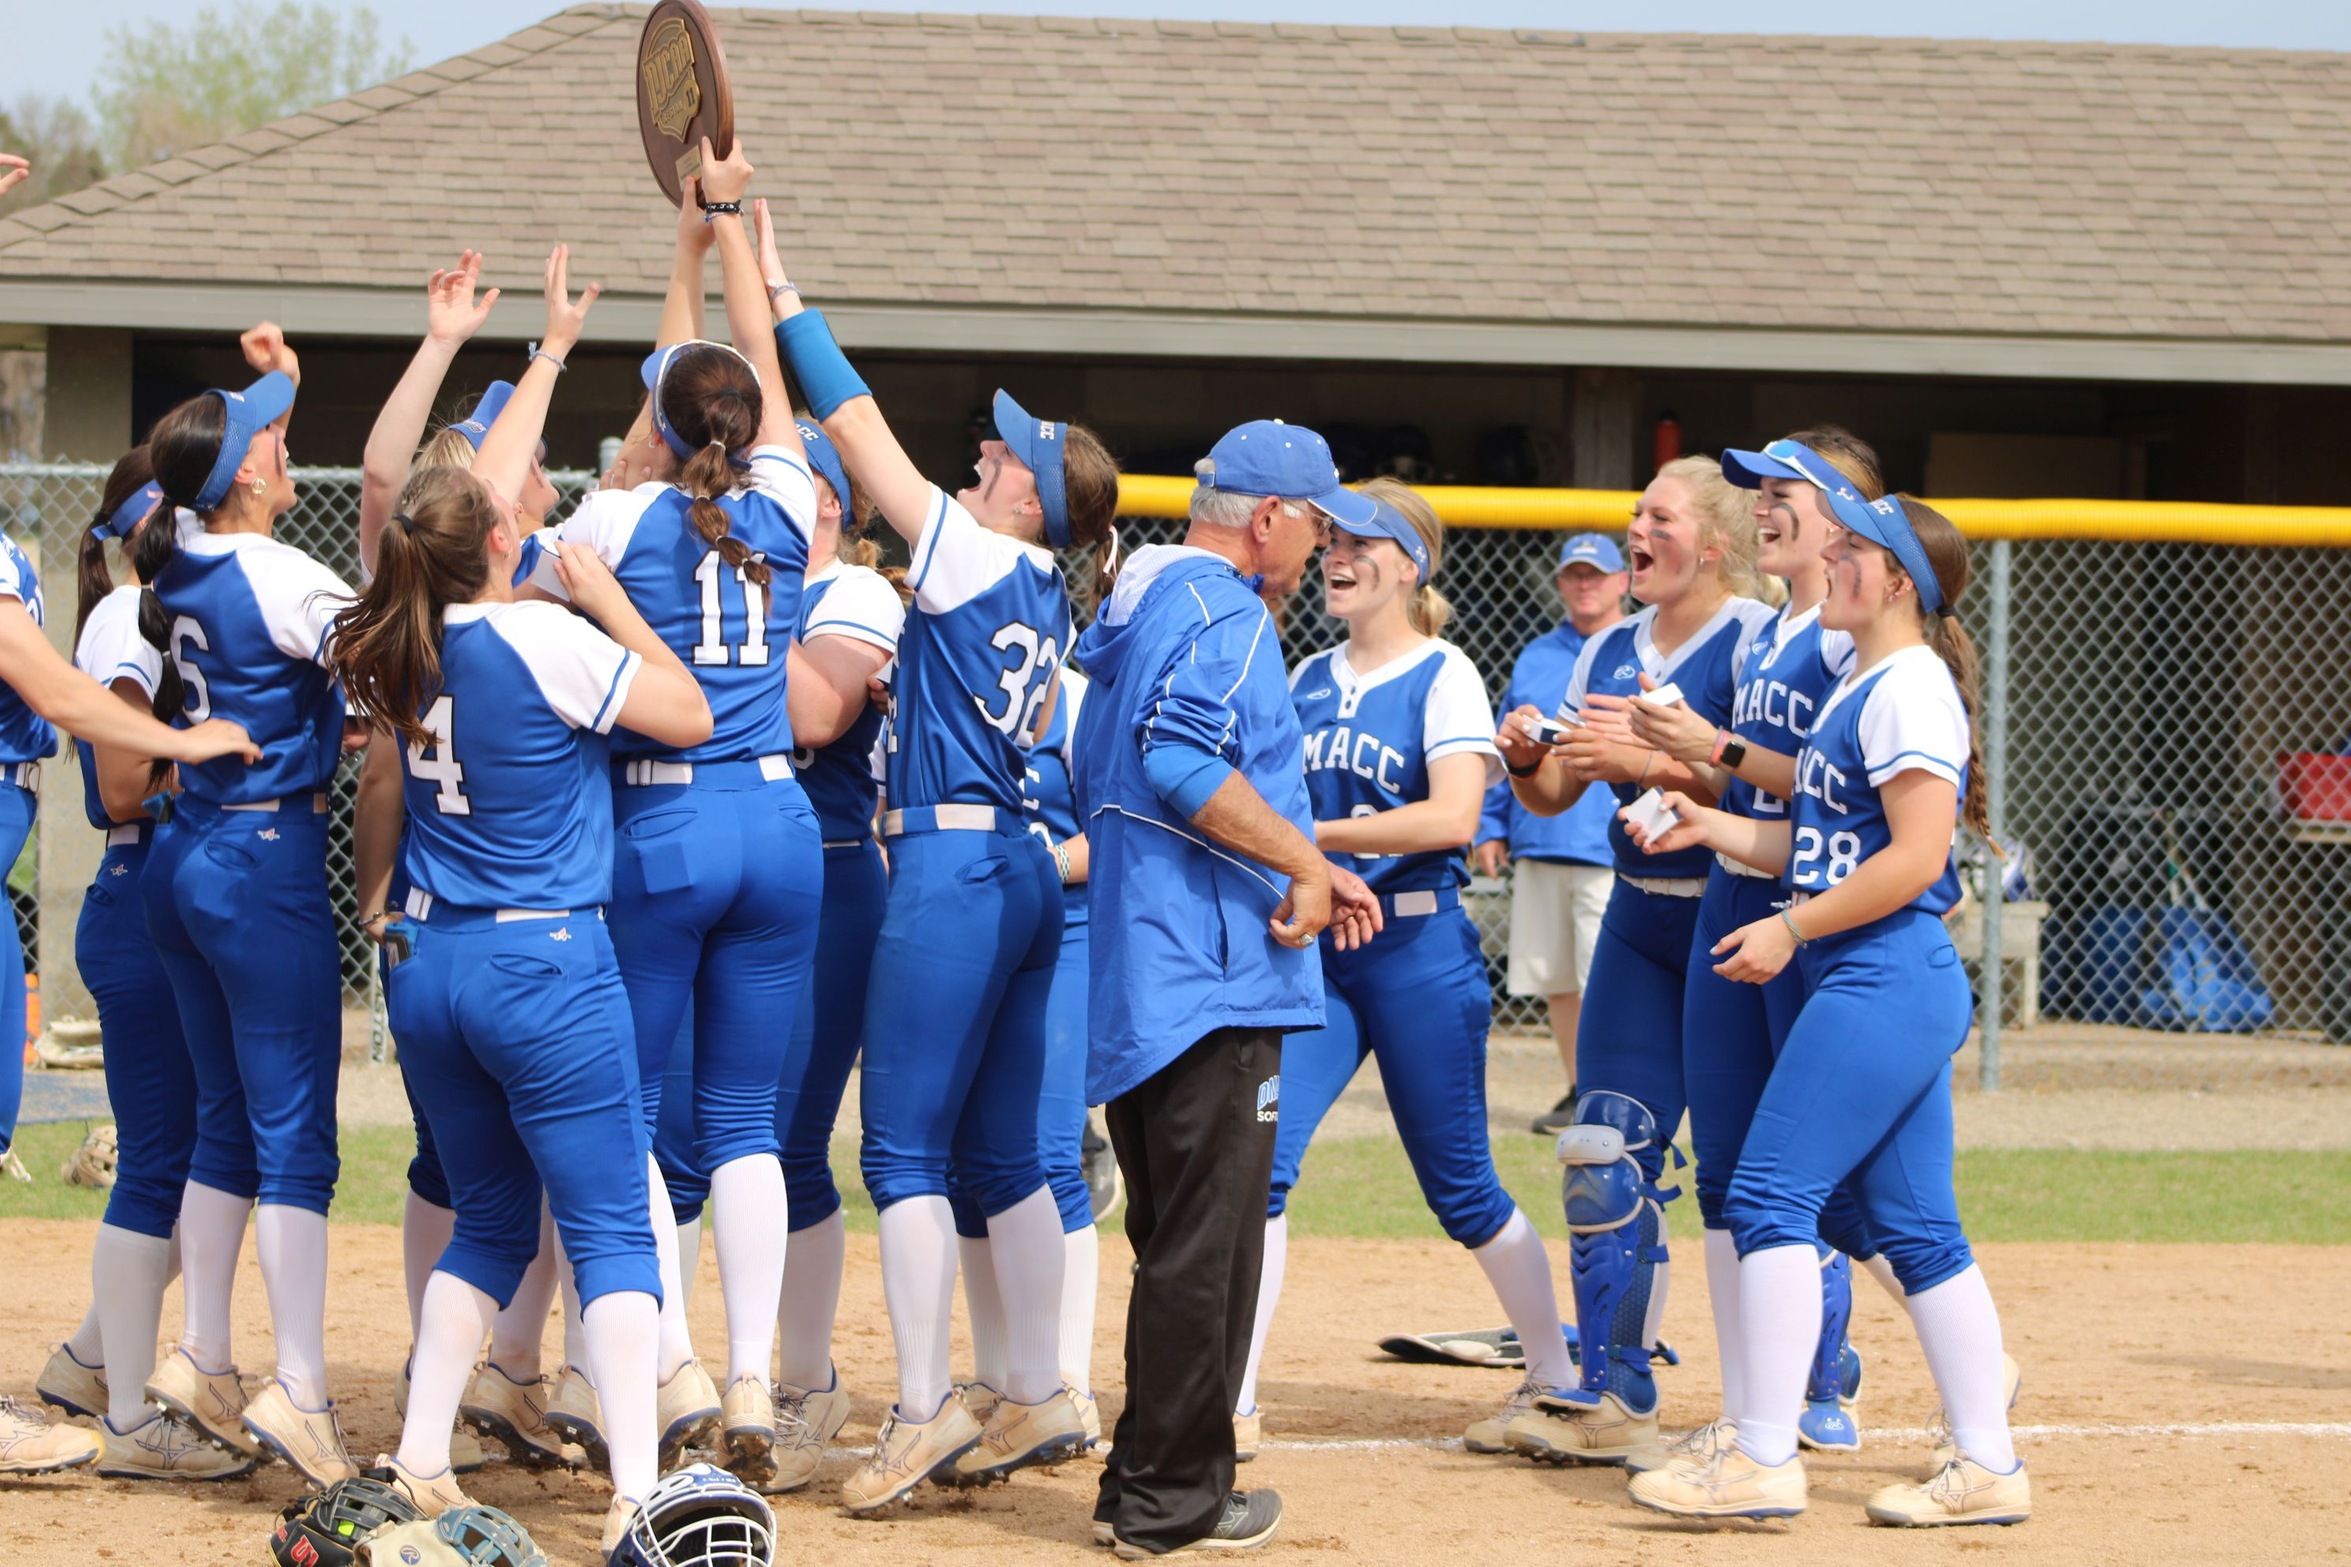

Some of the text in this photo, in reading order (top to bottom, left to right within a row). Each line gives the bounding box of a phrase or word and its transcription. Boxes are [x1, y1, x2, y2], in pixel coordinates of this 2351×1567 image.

[694, 550, 770, 666] 11
[169, 613, 211, 726] 6
[973, 620, 1059, 748] 32
[406, 695, 471, 816] 4
[1792, 825, 1861, 886] 28
